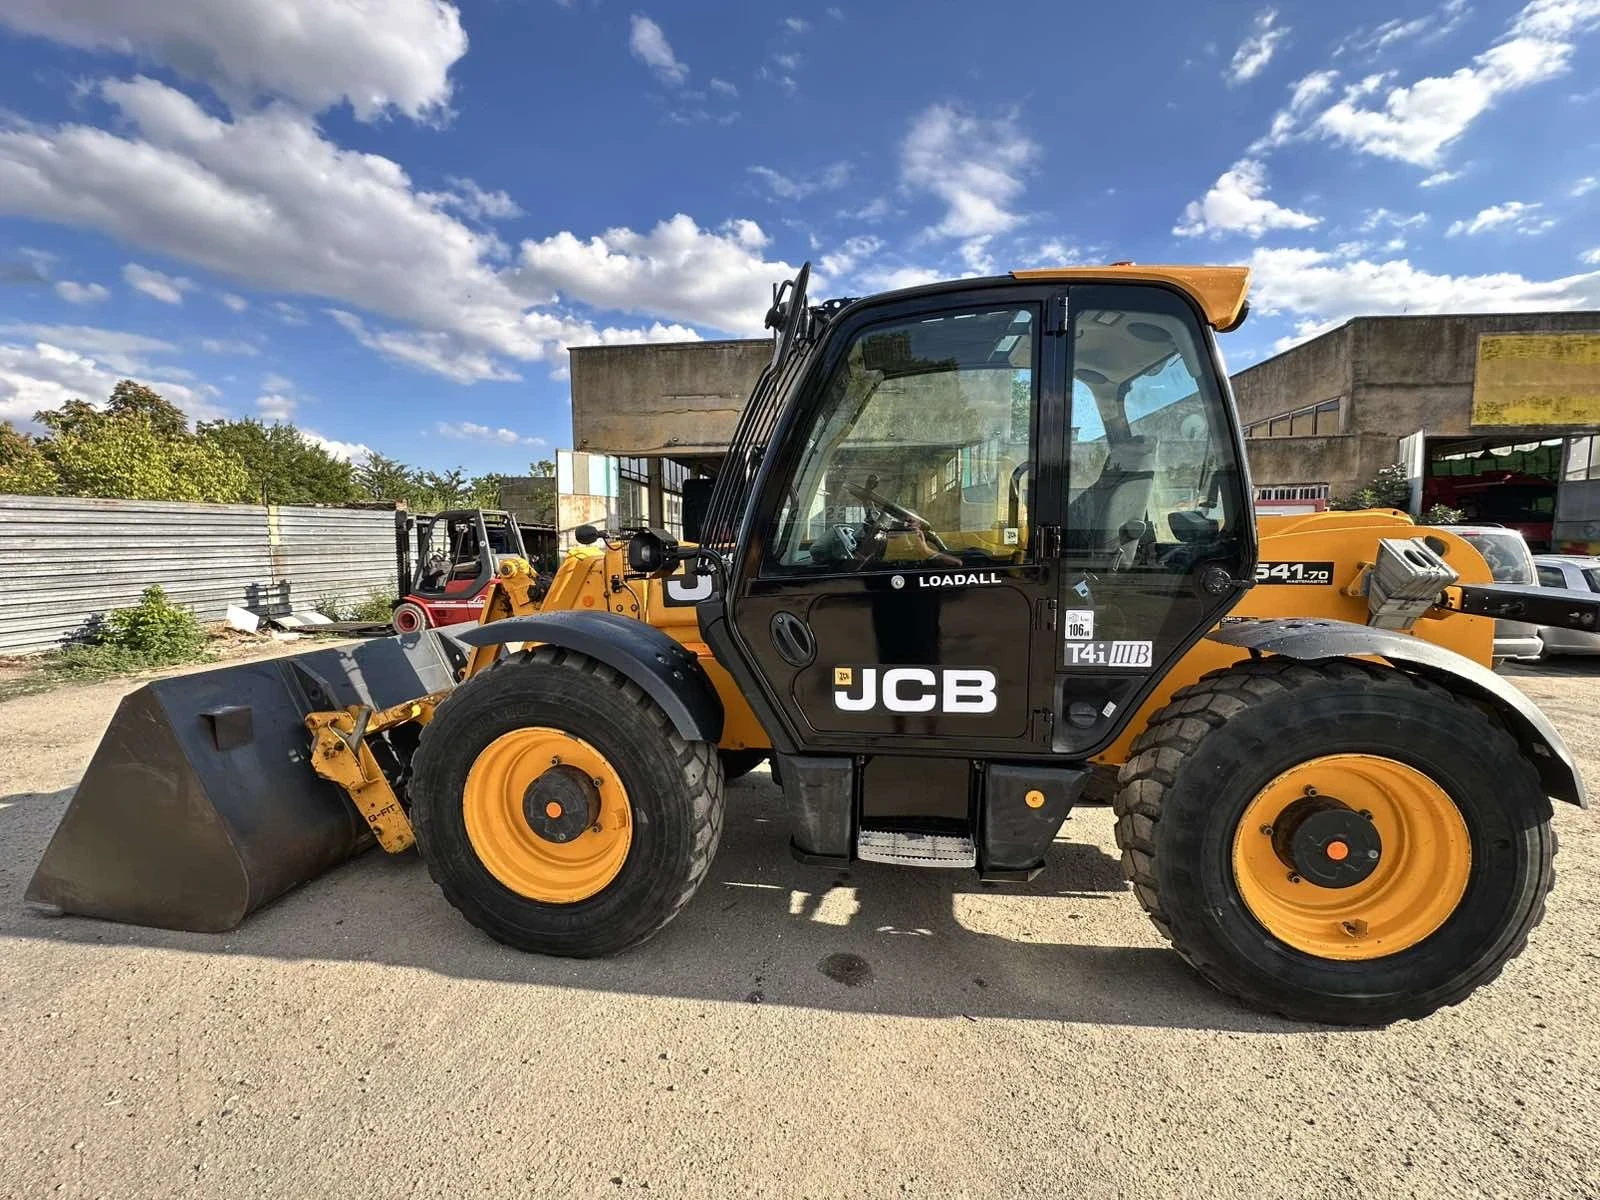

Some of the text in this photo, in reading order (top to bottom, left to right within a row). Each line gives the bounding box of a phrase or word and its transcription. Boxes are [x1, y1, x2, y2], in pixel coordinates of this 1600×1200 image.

[919, 572, 1002, 588] LOADALL
[1254, 563, 1329, 580] 541-70
[1066, 643, 1108, 664] T4i
[834, 668, 998, 713] JCB
